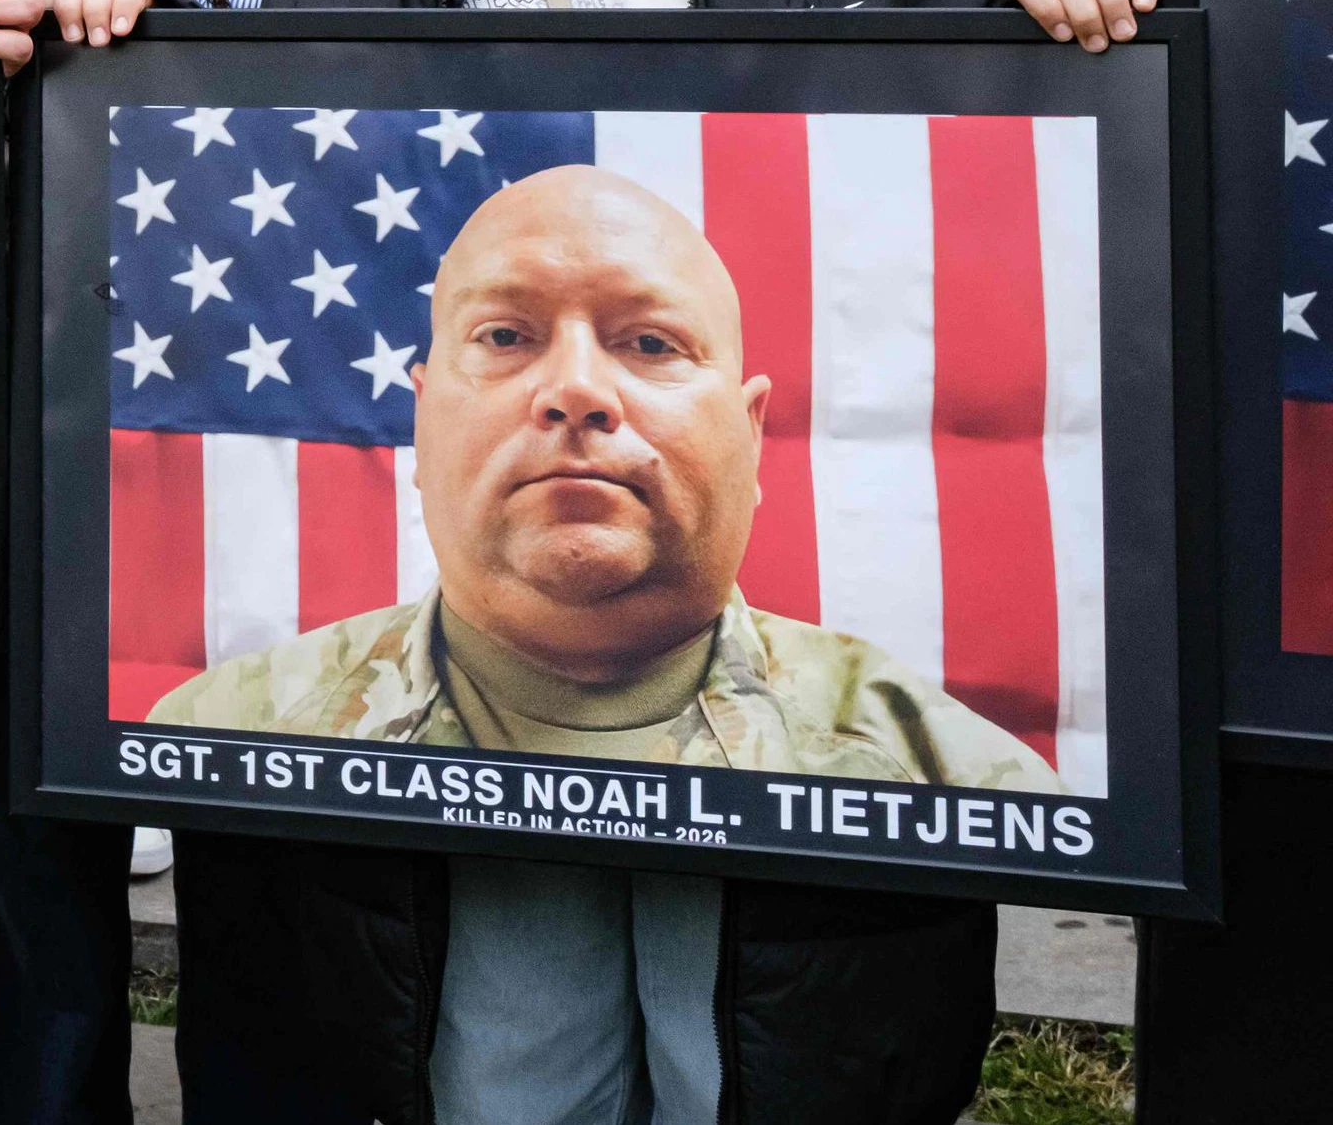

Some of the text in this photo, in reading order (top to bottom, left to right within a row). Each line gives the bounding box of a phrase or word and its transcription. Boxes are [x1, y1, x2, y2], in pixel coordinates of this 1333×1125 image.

[119, 739, 1094, 857] SGT. 1ST CLASS NOAH L. TIETJENS
[443, 806, 522, 829] KILLED
[530, 814, 552, 830] IN
[561, 817, 646, 838] ACTION
[676, 826, 727, 845] 2026
